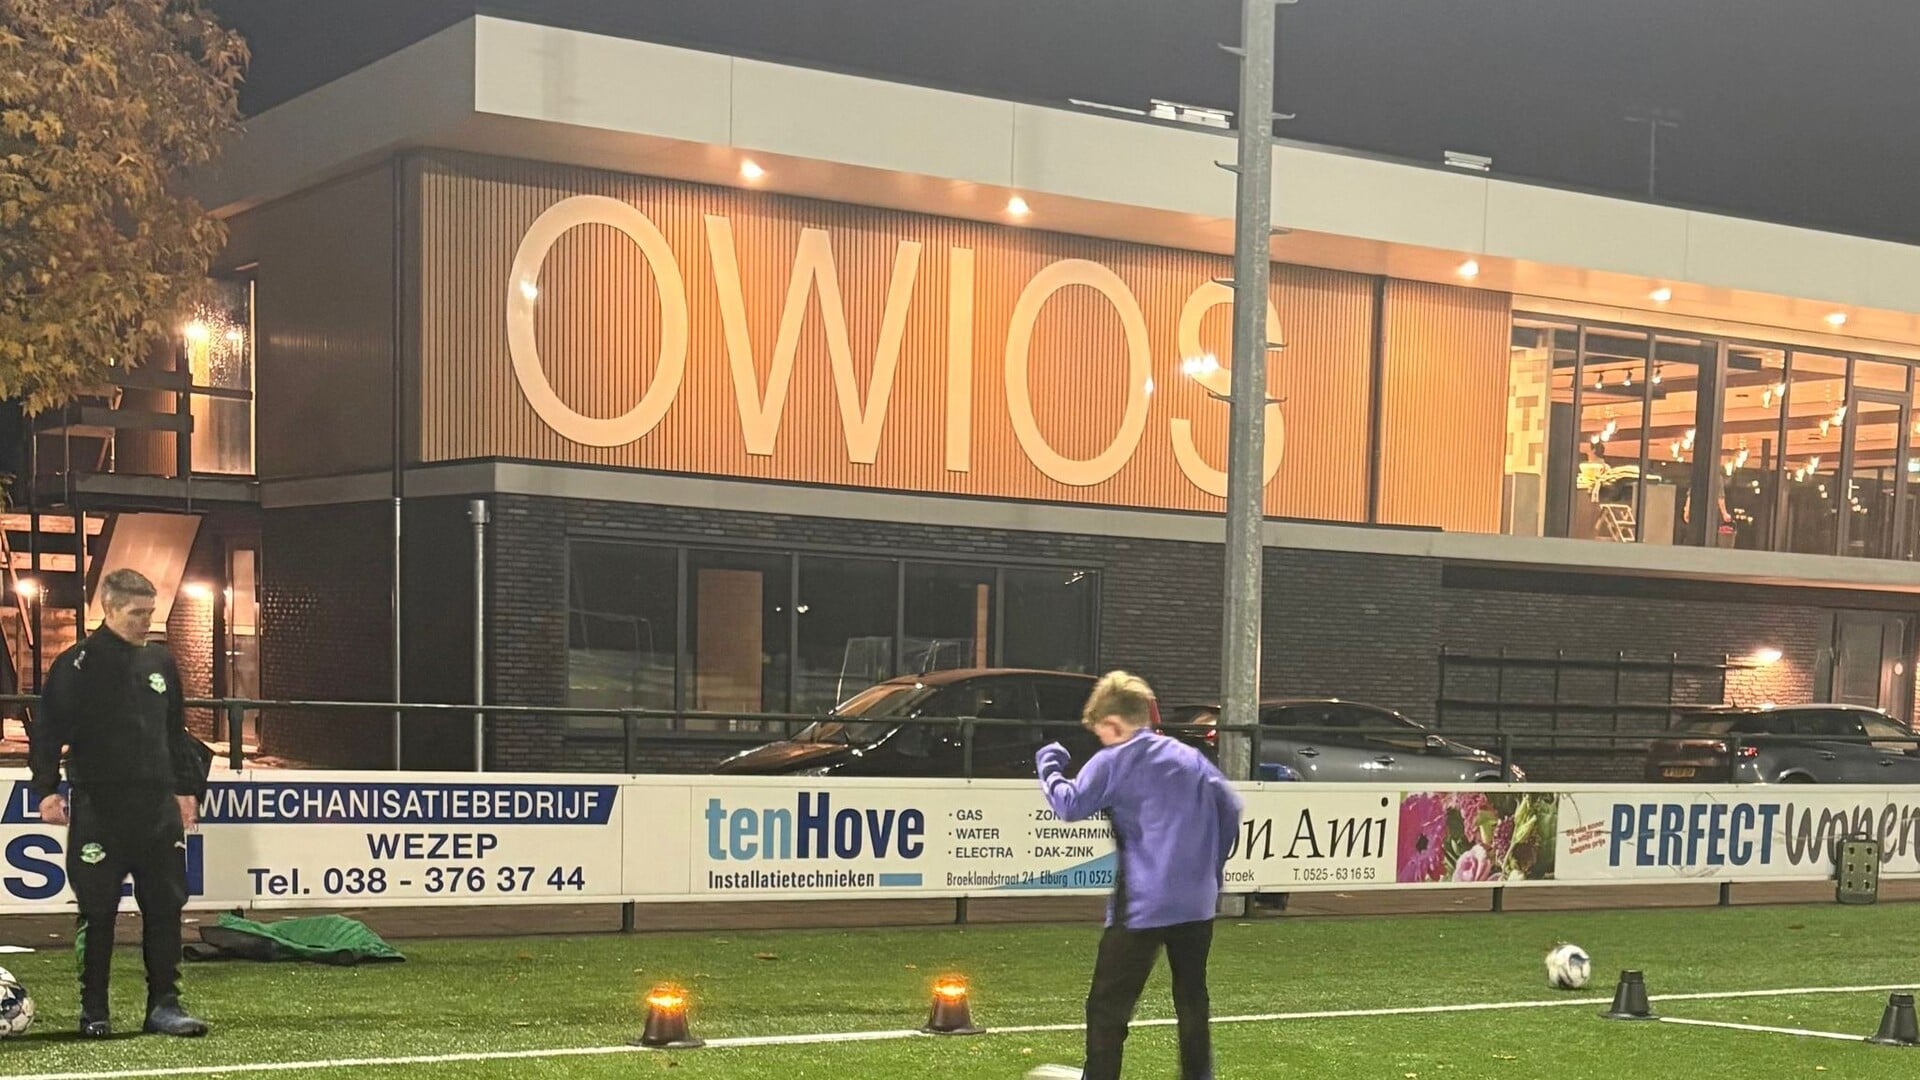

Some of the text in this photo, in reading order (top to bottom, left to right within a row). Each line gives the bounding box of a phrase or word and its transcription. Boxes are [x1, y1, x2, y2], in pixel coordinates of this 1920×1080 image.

[506, 194, 1285, 499] OWIOS
[22, 788, 598, 819] LWMECHANISATIEBEDRIJF
[956, 810, 983, 820] GAS
[705, 792, 924, 860] tenHove
[956, 829, 1000, 839] WATER
[1282, 797, 1388, 859] Ami
[1609, 803, 1780, 866] PERFECT
[367, 834, 498, 859] WEZEP
[956, 847, 1014, 858] ELECTRA
[1035, 847, 1094, 857] DAK-ZINK
[248, 869, 310, 895] Tel.
[324, 868, 387, 893] 038
[425, 867, 485, 892] 376
[496, 867, 535, 892] 37
[546, 867, 585, 891] 44
[709, 870, 875, 889] Installatietechnieken
[947, 871, 1019, 886] Broeklandstraat
[1022, 871, 1034, 885] 24
[1040, 869, 1068, 887] Elburg
[1225, 869, 1254, 882] broek
[1293, 868, 1301, 881] T.
[1303, 868, 1328, 881] 0525
[1336, 868, 1348, 880] 63
[1351, 868, 1361, 880] 16
[1364, 867, 1376, 880] 53
